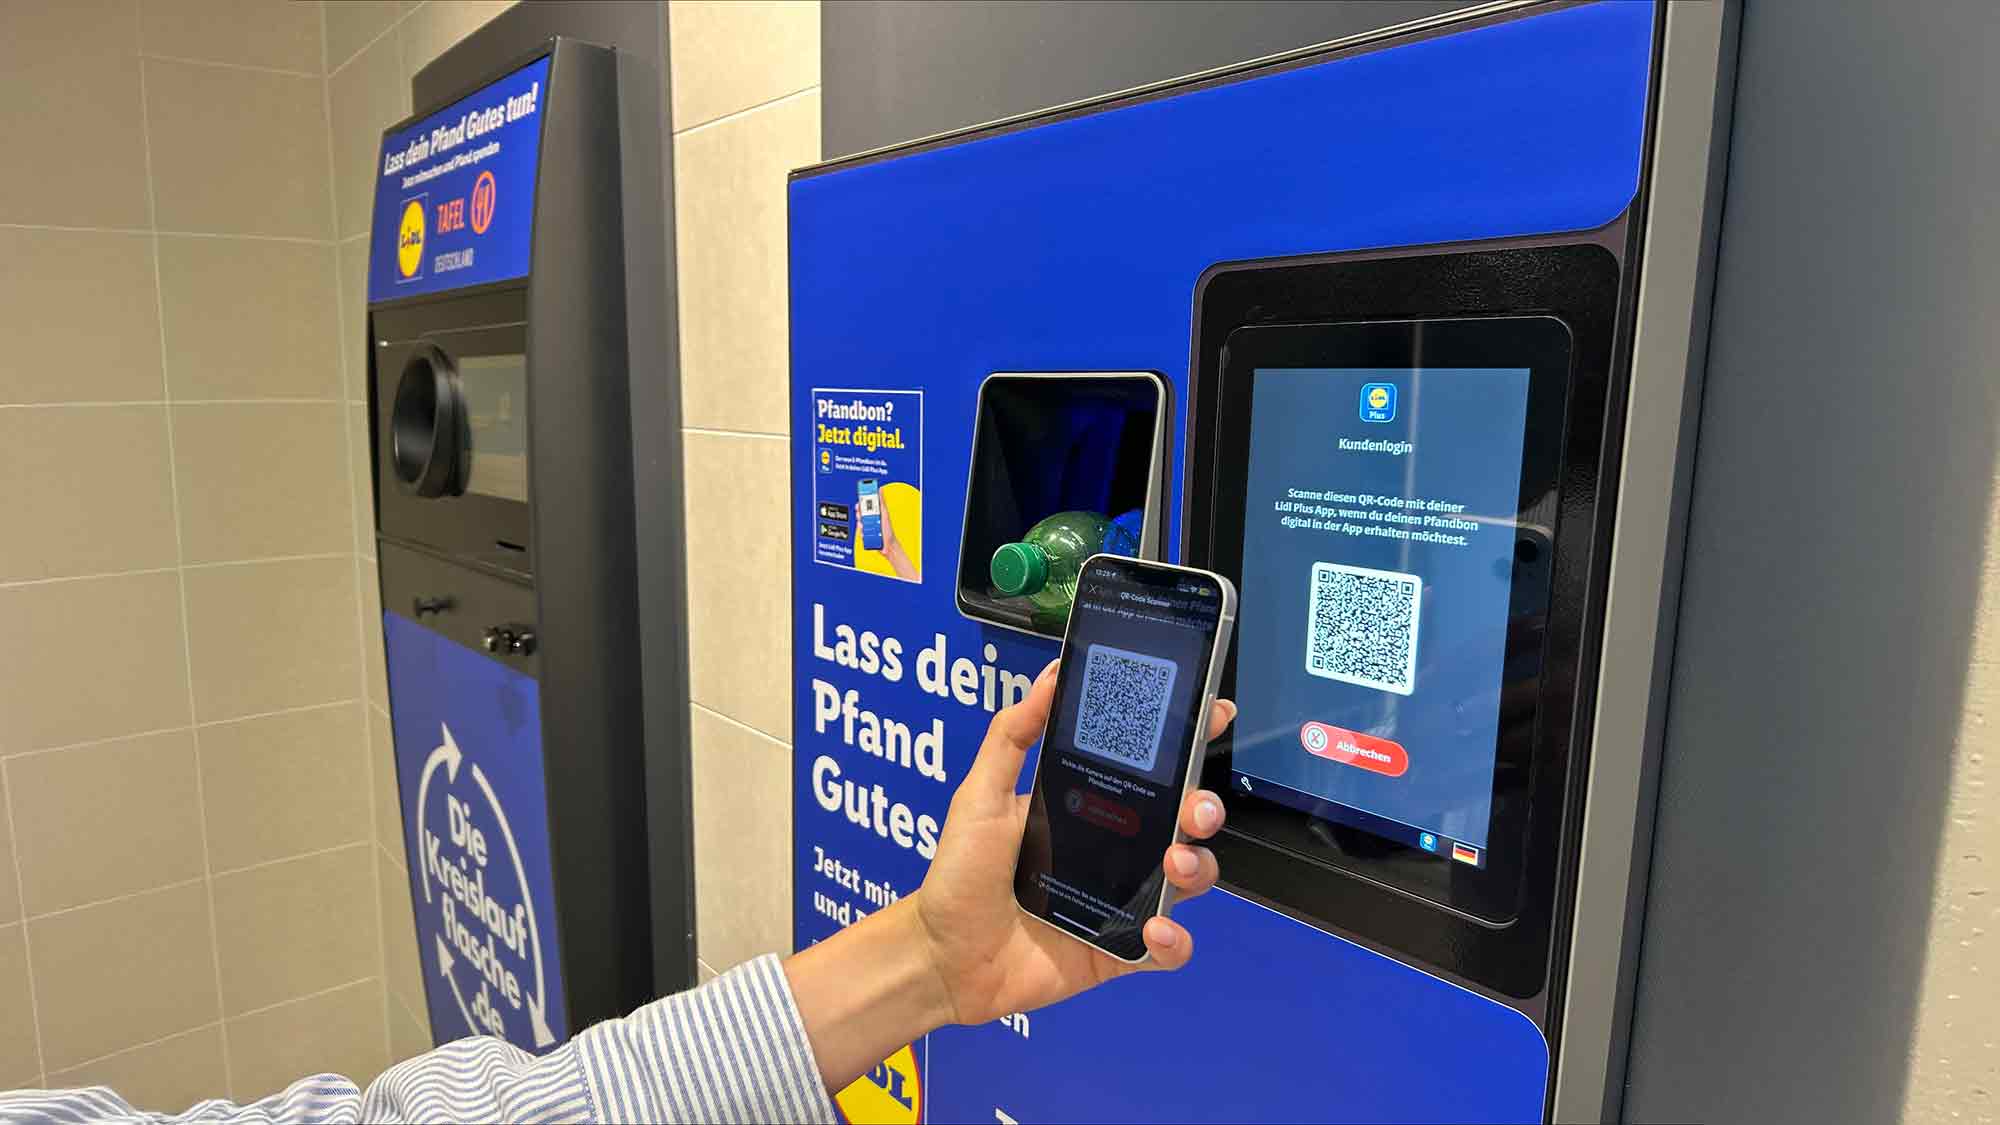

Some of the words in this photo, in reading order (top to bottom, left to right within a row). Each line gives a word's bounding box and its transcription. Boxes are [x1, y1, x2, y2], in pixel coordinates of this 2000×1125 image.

[384, 152, 405, 176] Lass
[405, 134, 429, 166] dein
[430, 116, 467, 156] Pfand
[467, 105, 505, 139] Gutes
[506, 82, 538, 122] tun!
[437, 198, 465, 233] TAFEL
[434, 248, 474, 272] DEUTSCHLAND
[817, 399, 894, 421] Pfandbon?
[1369, 411, 1385, 419] Plus
[818, 423, 851, 445] Jetzt
[853, 425, 905, 452] digital.
[1339, 438, 1412, 455] Kundenlogin
[1275, 501, 1292, 511] Lidl
[1293, 503, 1313, 514] Plus
[1314, 505, 1337, 518] App,
[1339, 509, 1367, 519] wenn
[1369, 510, 1383, 521] du
[1384, 512, 1422, 525] deinen
[1424, 515, 1478, 531] Pfandbon
[1288, 488, 1322, 500] Scanne
[1324, 491, 1356, 503] diesen
[1358, 494, 1404, 507] QR-Code
[1405, 499, 1426, 510] mit
[1426, 500, 1464, 513] deiner
[1281, 516, 1311, 528] digital
[1312, 519, 1323, 529] in
[1323, 520, 1342, 531] der
[1342, 523, 1363, 536] App
[1364, 525, 1409, 539] erhalten
[1411, 530, 1468, 546] möchtest.
[813, 603, 904, 683] Lass
[916, 633, 1032, 711] dein
[812, 679, 947, 783] Pfand
[1336, 741, 1392, 763] Abbrechen
[812, 755, 939, 861] Gutes
[448, 793, 488, 867] Die
[814, 845, 860, 894] Jetzt
[425, 829, 527, 960] Kreislauf
[814, 891, 850, 927] und
